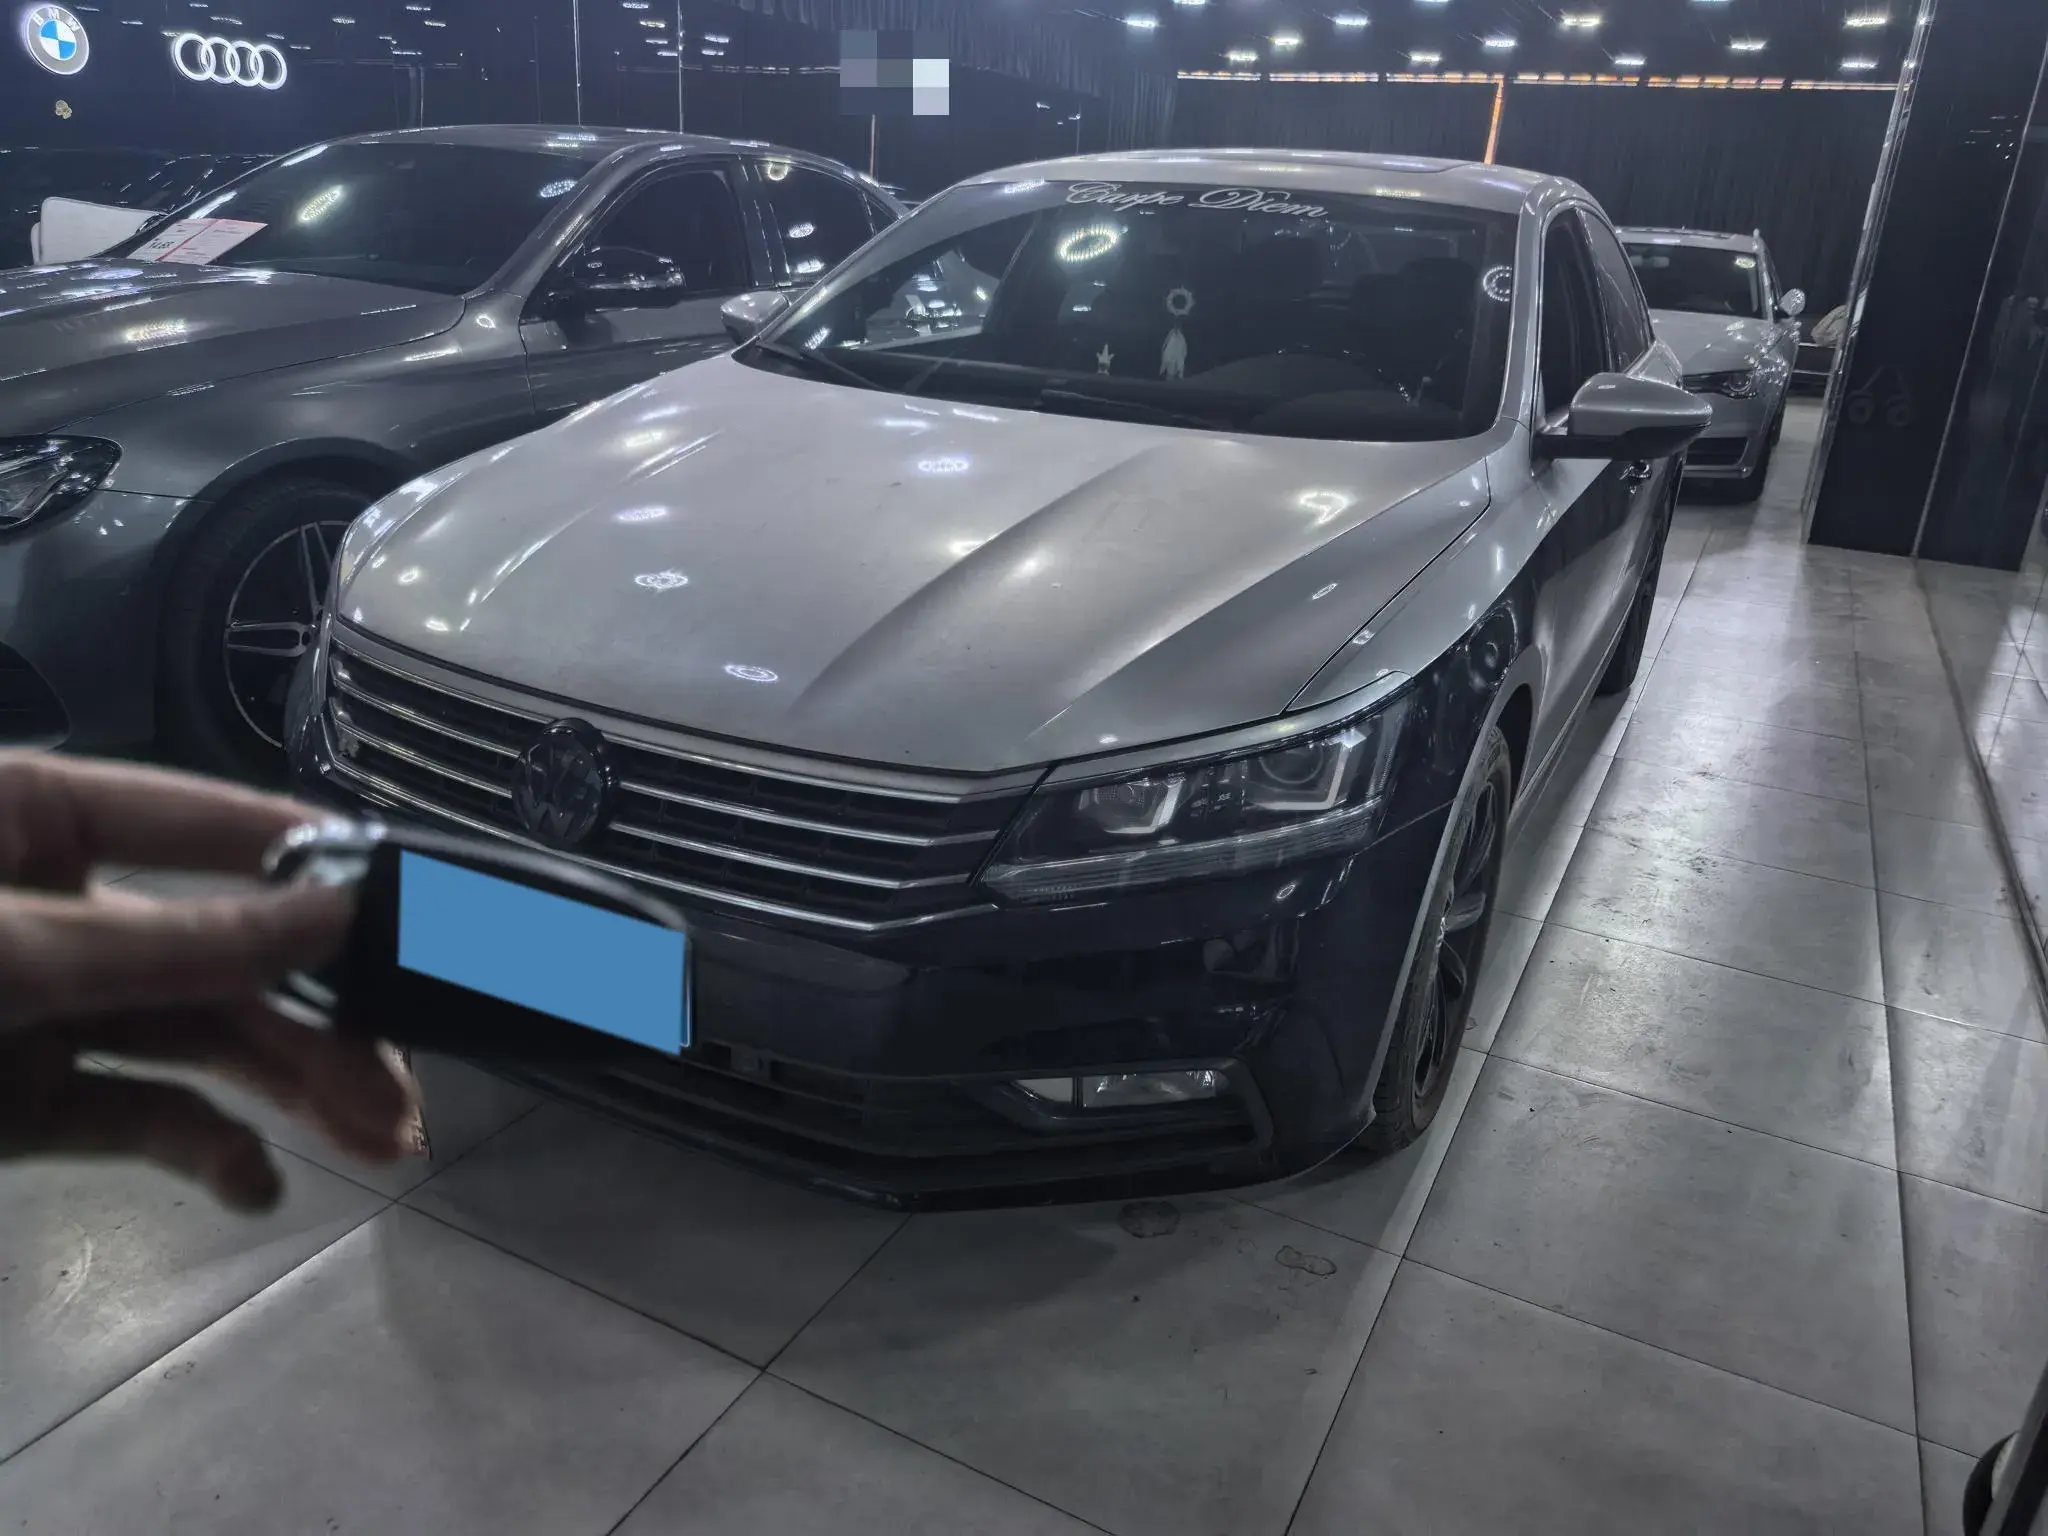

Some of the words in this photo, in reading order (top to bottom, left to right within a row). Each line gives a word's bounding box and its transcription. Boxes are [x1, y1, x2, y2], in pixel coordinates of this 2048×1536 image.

[32, 7, 81, 32] BMW
[1066, 181, 1185, 212] Carpe
[1188, 187, 1329, 218] Diem
